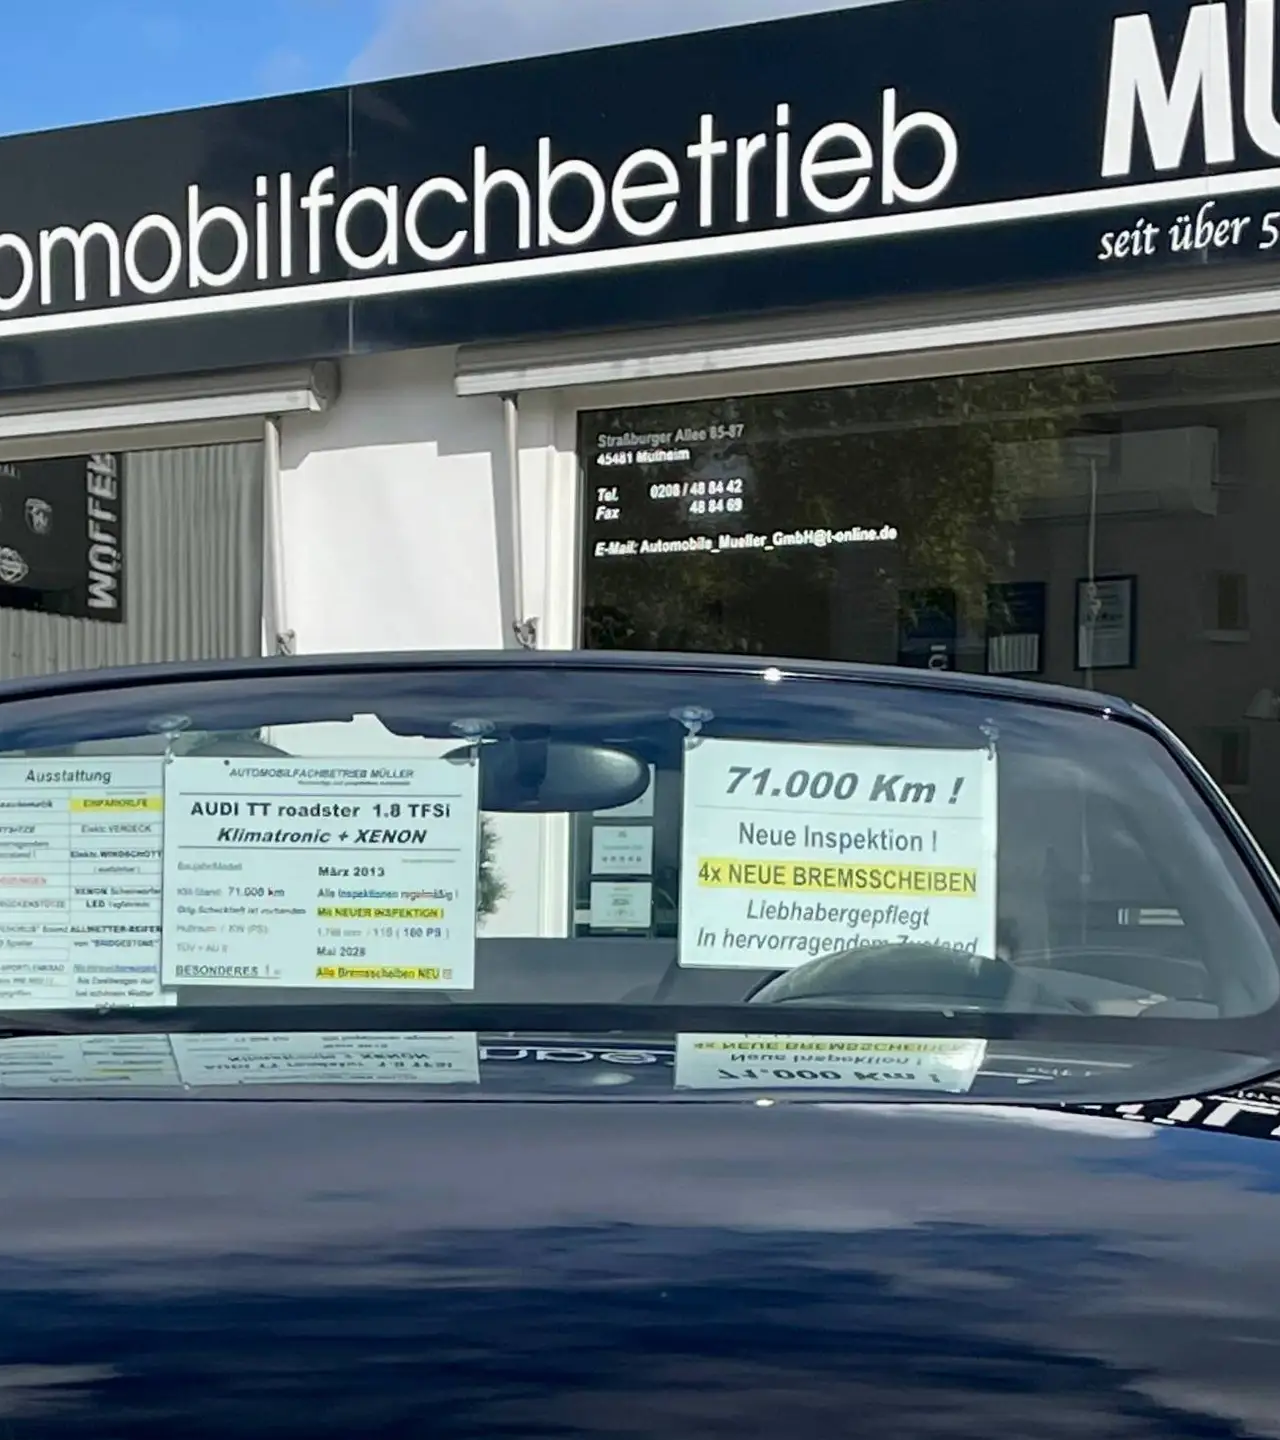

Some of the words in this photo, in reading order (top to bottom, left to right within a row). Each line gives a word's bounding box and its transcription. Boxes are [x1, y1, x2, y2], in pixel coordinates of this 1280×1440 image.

[1097, 219, 1160, 261] seit
[1169, 201, 1251, 250] über
[675, 428, 707, 442] Allee
[650, 484, 680, 499] 0208
[689, 481, 705, 495] 48
[708, 480, 723, 494] 84
[726, 479, 743, 493] 42
[595, 505, 620, 520] Fax
[689, 500, 705, 514] 48
[708, 499, 723, 513] 84
[25, 769, 111, 784] Ausstattung
[726, 766, 859, 800] 71.000
[869, 774, 936, 803] Km
[948, 777, 965, 805] !
[190, 802, 238, 816] AUDI
[247, 802, 271, 817] TT
[278, 802, 360, 818] roadster
[373, 803, 401, 818] 1.8
[217, 827, 331, 843] Klimatronic
[338, 832, 348, 842] +
[355, 829, 427, 844] XENON
[738, 822, 796, 847] Neue
[804, 825, 923, 854] Inspektion
[318, 866, 349, 877] März
[353, 867, 385, 877] 2013
[698, 861, 721, 883] 4x
[728, 863, 785, 885] NEUE
[793, 866, 977, 893] BREMSSCHEIBEN
[747, 899, 930, 928] Liebhabergepflegt
[696, 927, 716, 946] In
[175, 965, 259, 976] BESONDERES
